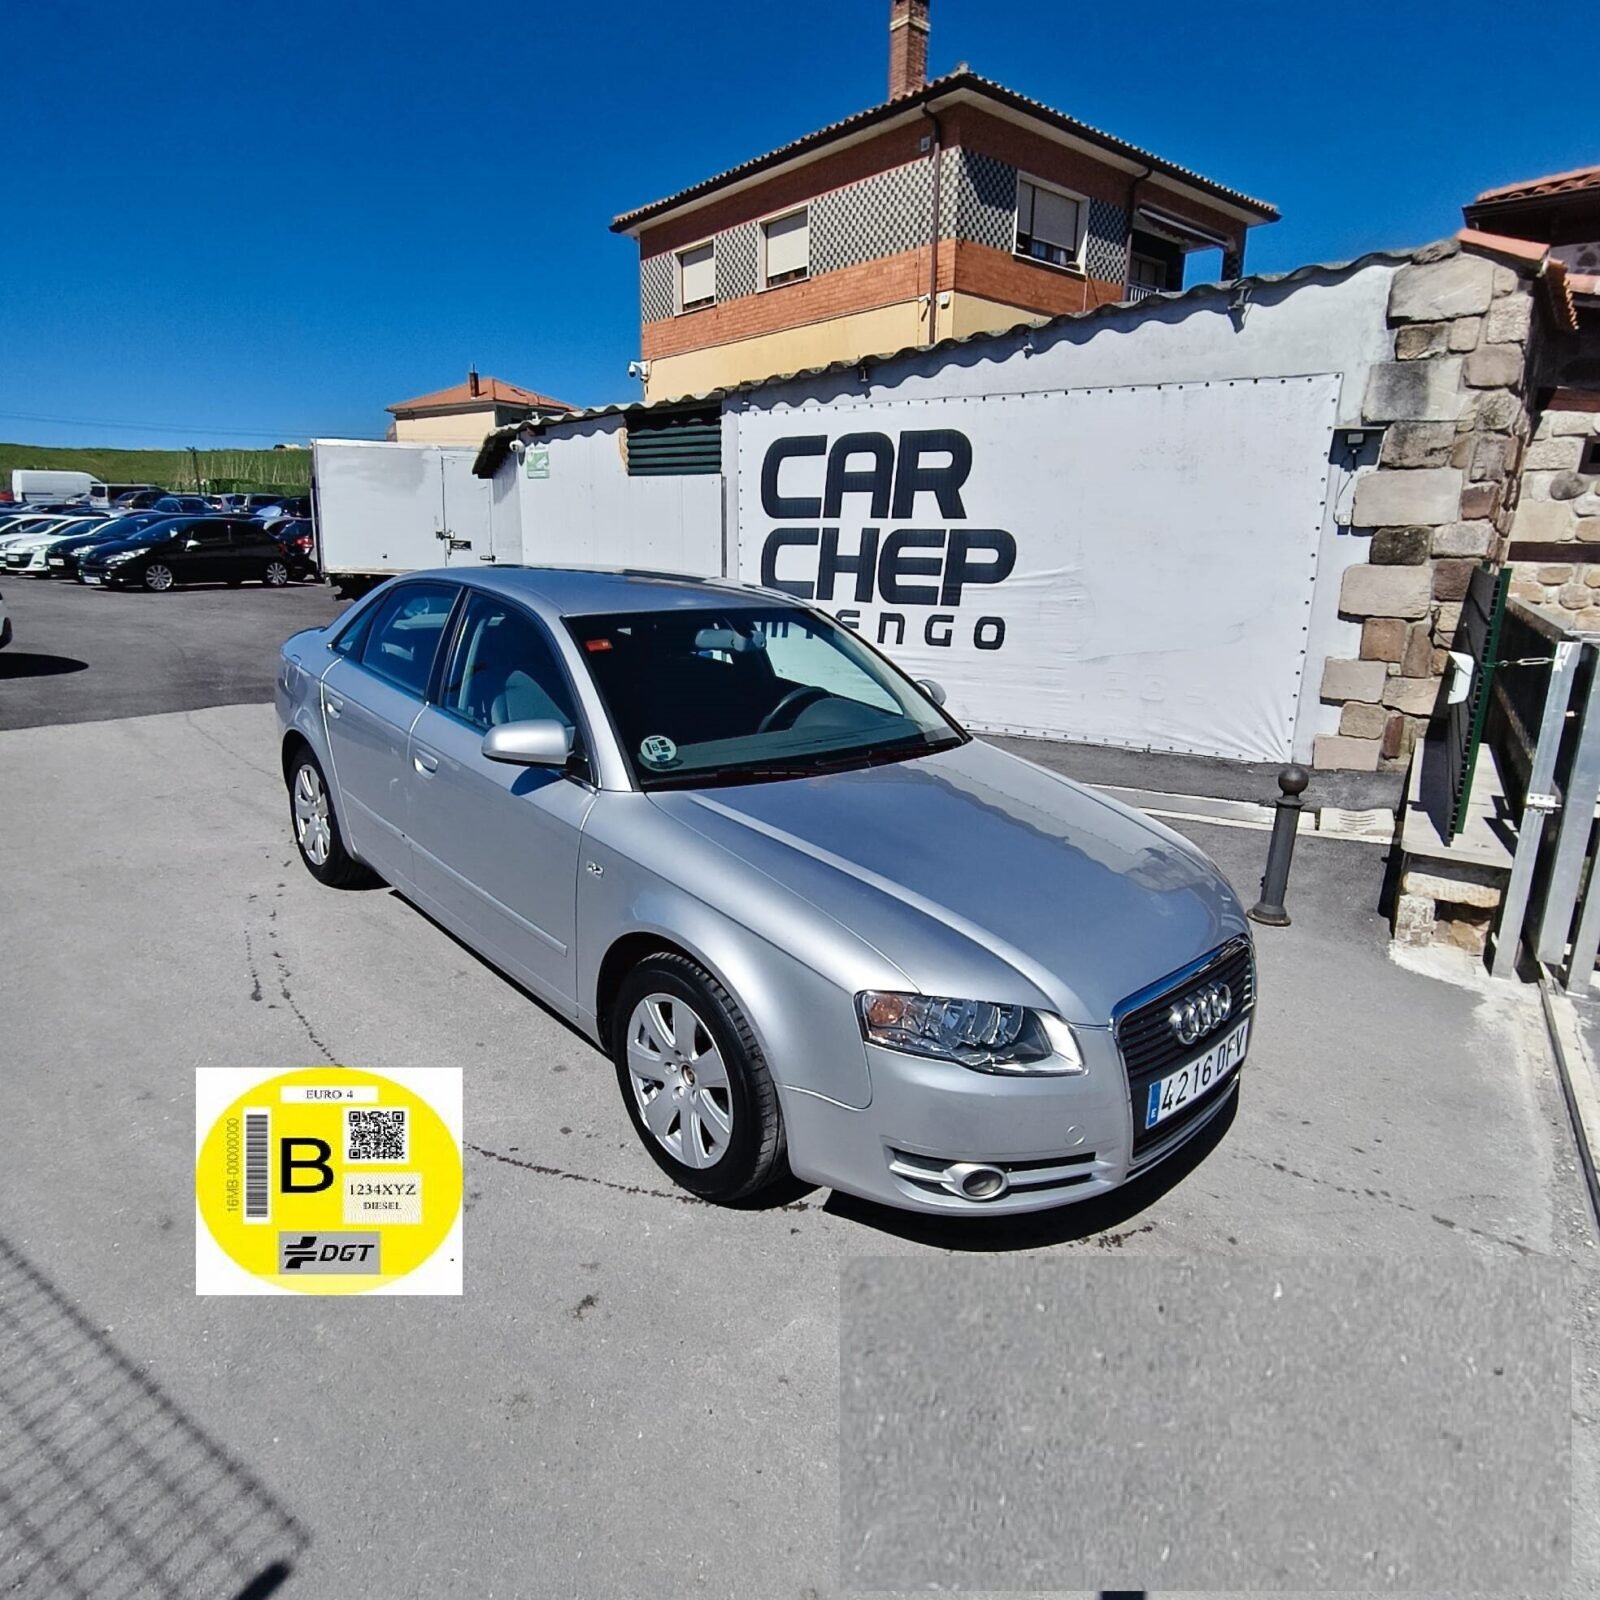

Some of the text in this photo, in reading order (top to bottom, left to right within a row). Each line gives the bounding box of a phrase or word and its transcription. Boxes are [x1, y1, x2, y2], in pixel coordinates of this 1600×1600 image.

[760, 429, 973, 520] CAR
[760, 528, 1017, 607] CHEP
[1161, 1055, 1212, 1110] 4216
[1216, 1025, 1246, 1076] DFV
